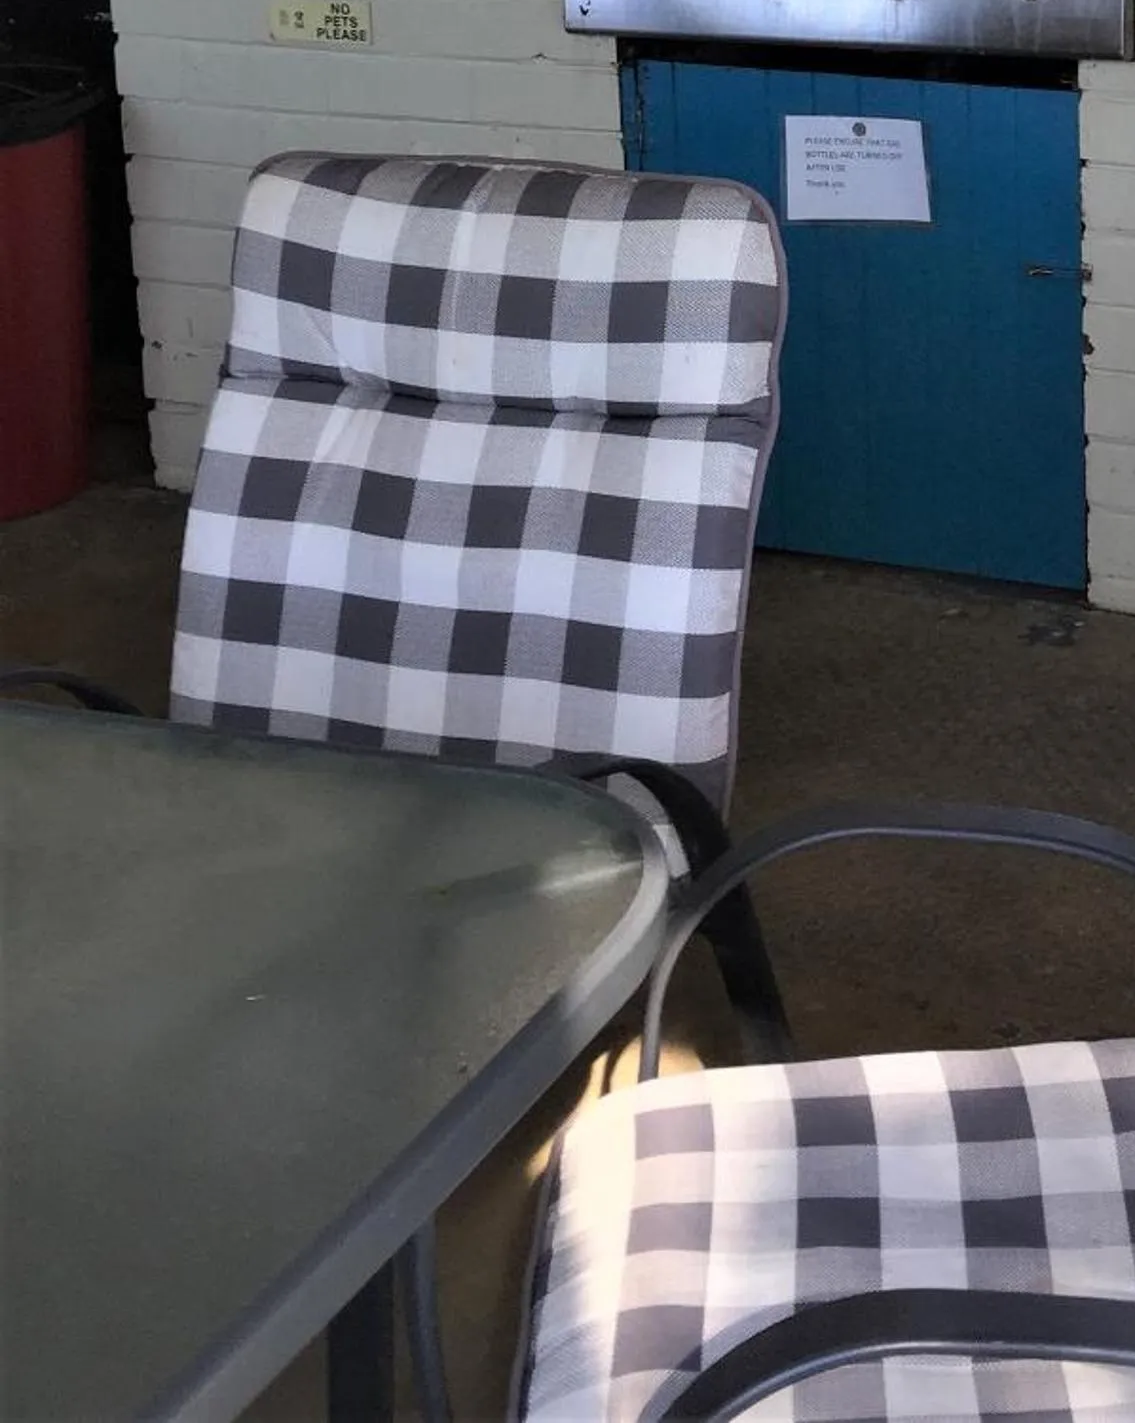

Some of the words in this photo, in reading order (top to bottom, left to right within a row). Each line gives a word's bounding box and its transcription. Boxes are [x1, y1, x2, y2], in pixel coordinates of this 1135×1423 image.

[331, 3, 350, 15] NO
[325, 16, 358, 28] PETS
[316, 28, 366, 42] PLEASE
